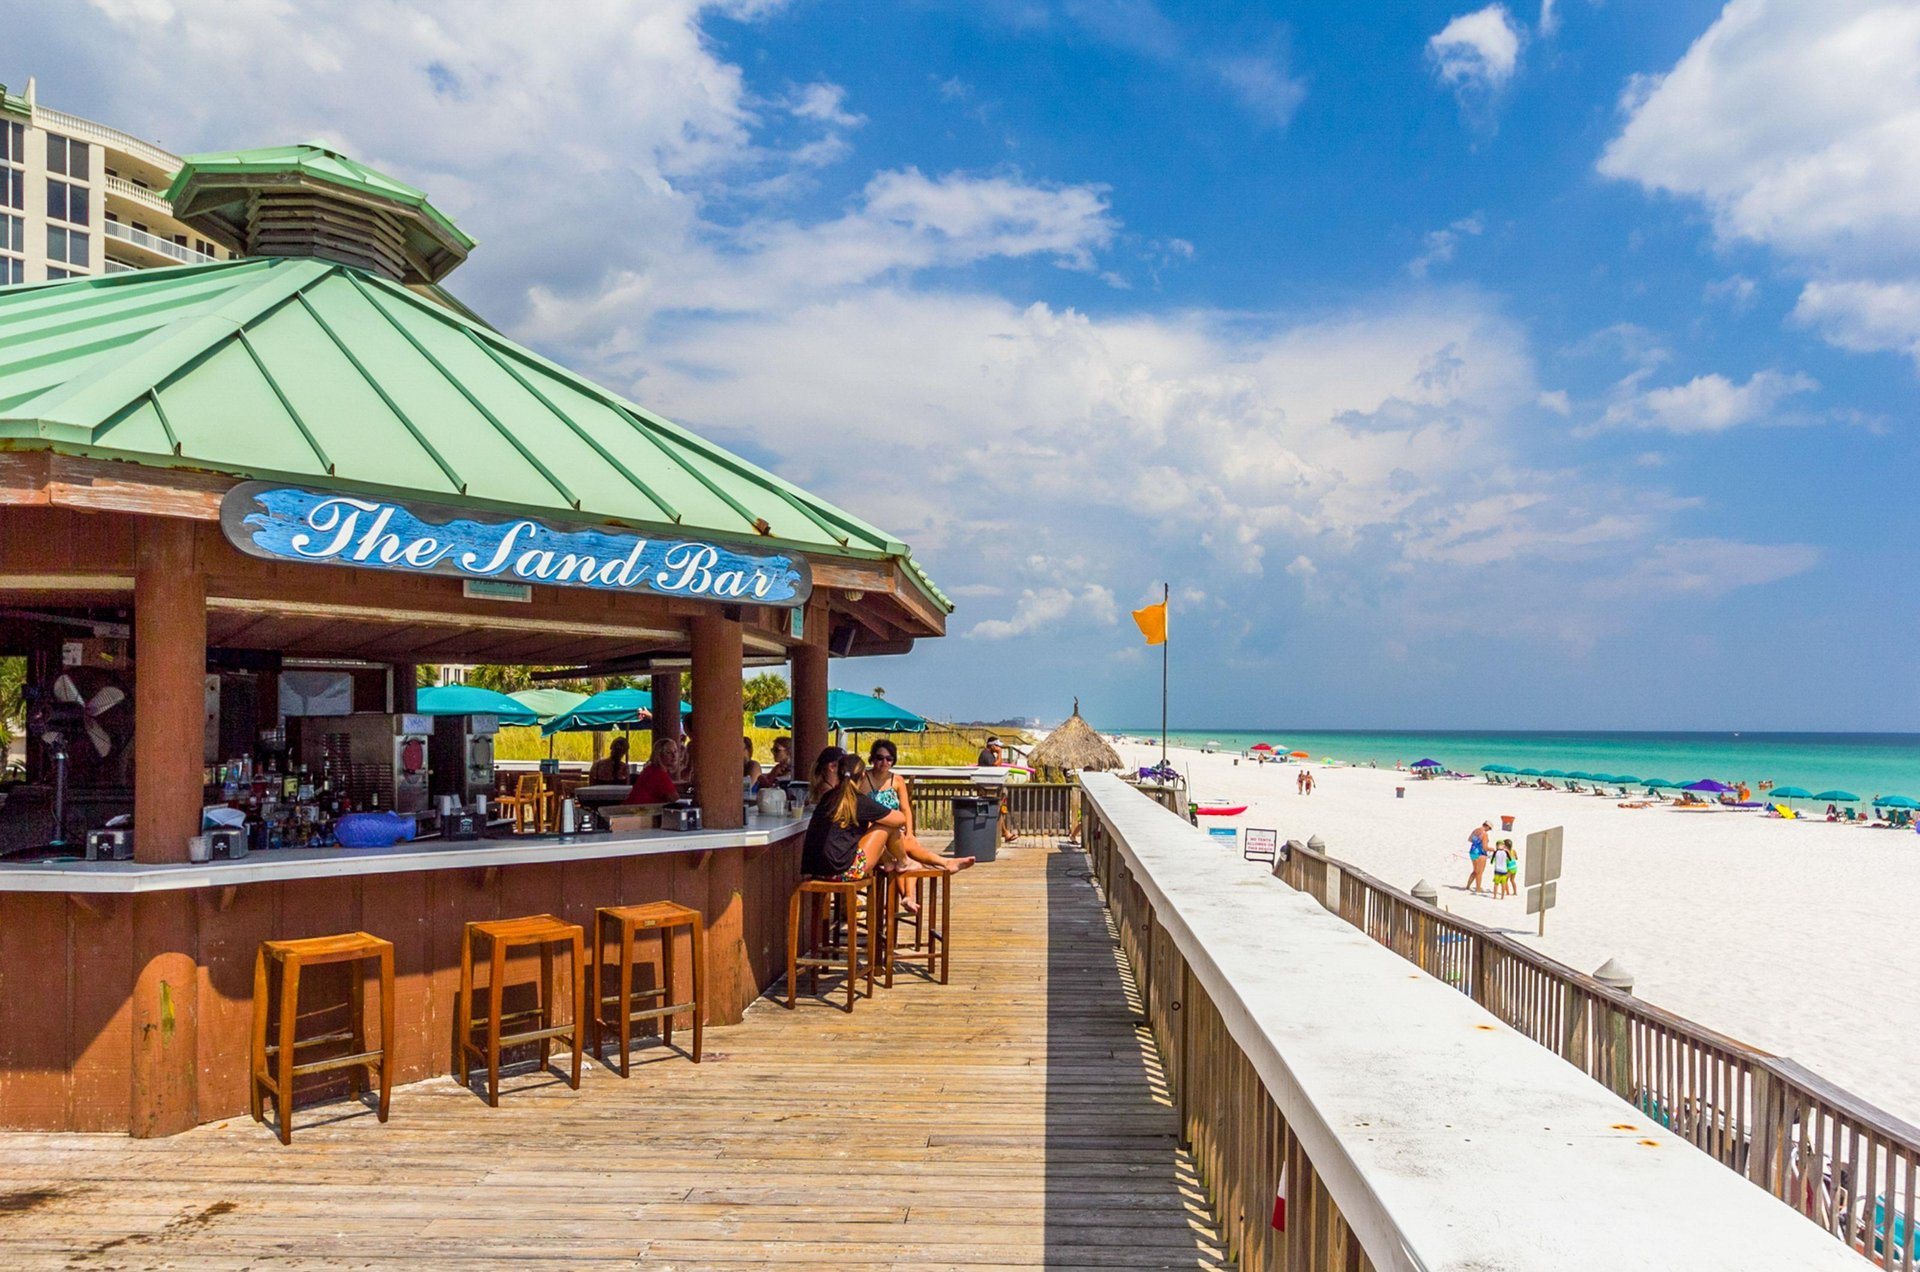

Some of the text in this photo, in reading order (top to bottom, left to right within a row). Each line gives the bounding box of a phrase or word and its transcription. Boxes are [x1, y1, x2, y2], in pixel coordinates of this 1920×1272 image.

[291, 498, 777, 598] The Sand Bar
